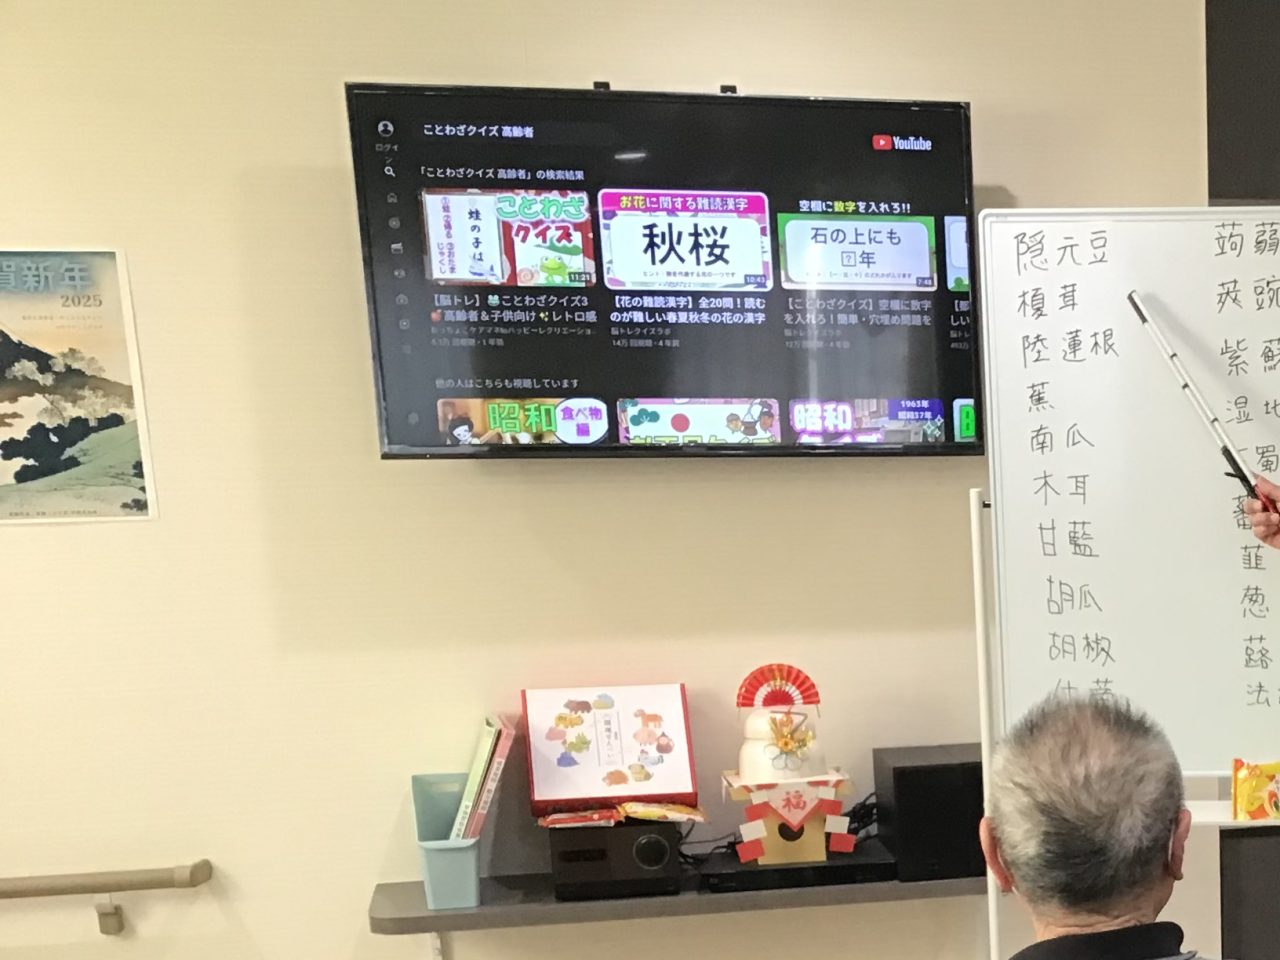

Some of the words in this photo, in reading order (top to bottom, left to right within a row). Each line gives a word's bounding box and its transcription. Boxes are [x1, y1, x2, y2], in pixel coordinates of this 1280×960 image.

[423, 124, 499, 138] ことわざクイズ
[892, 135, 932, 151] YouTube
[496, 195, 586, 220] ことわざ
[620, 195, 749, 211] お花に関する難読漢字
[514, 224, 574, 244] クイズ
[642, 222, 730, 267] 秋桜
[811, 227, 901, 246] 石の上にも
[1214, 221, 1280, 258] 蒟蒻
[1013, 229, 1109, 277] 隠元豆
[60, 294, 103, 308] 2025
[610, 310, 766, 325] のが難しい春夏秋冬の花の漢字
[1021, 328, 1119, 369] 陸蓮根
[487, 403, 557, 433] 昭和
[793, 402, 852, 432] 昭和
[1031, 422, 1095, 456] 南瓜
[1033, 469, 1090, 506] 木耳
[1038, 518, 1100, 558] 甘藍
[1046, 574, 1103, 615] 胡瓜
[1240, 585, 1270, 619] 葱
[1048, 631, 1117, 668] 胡椒
[1243, 635, 1273, 670] 蕗
